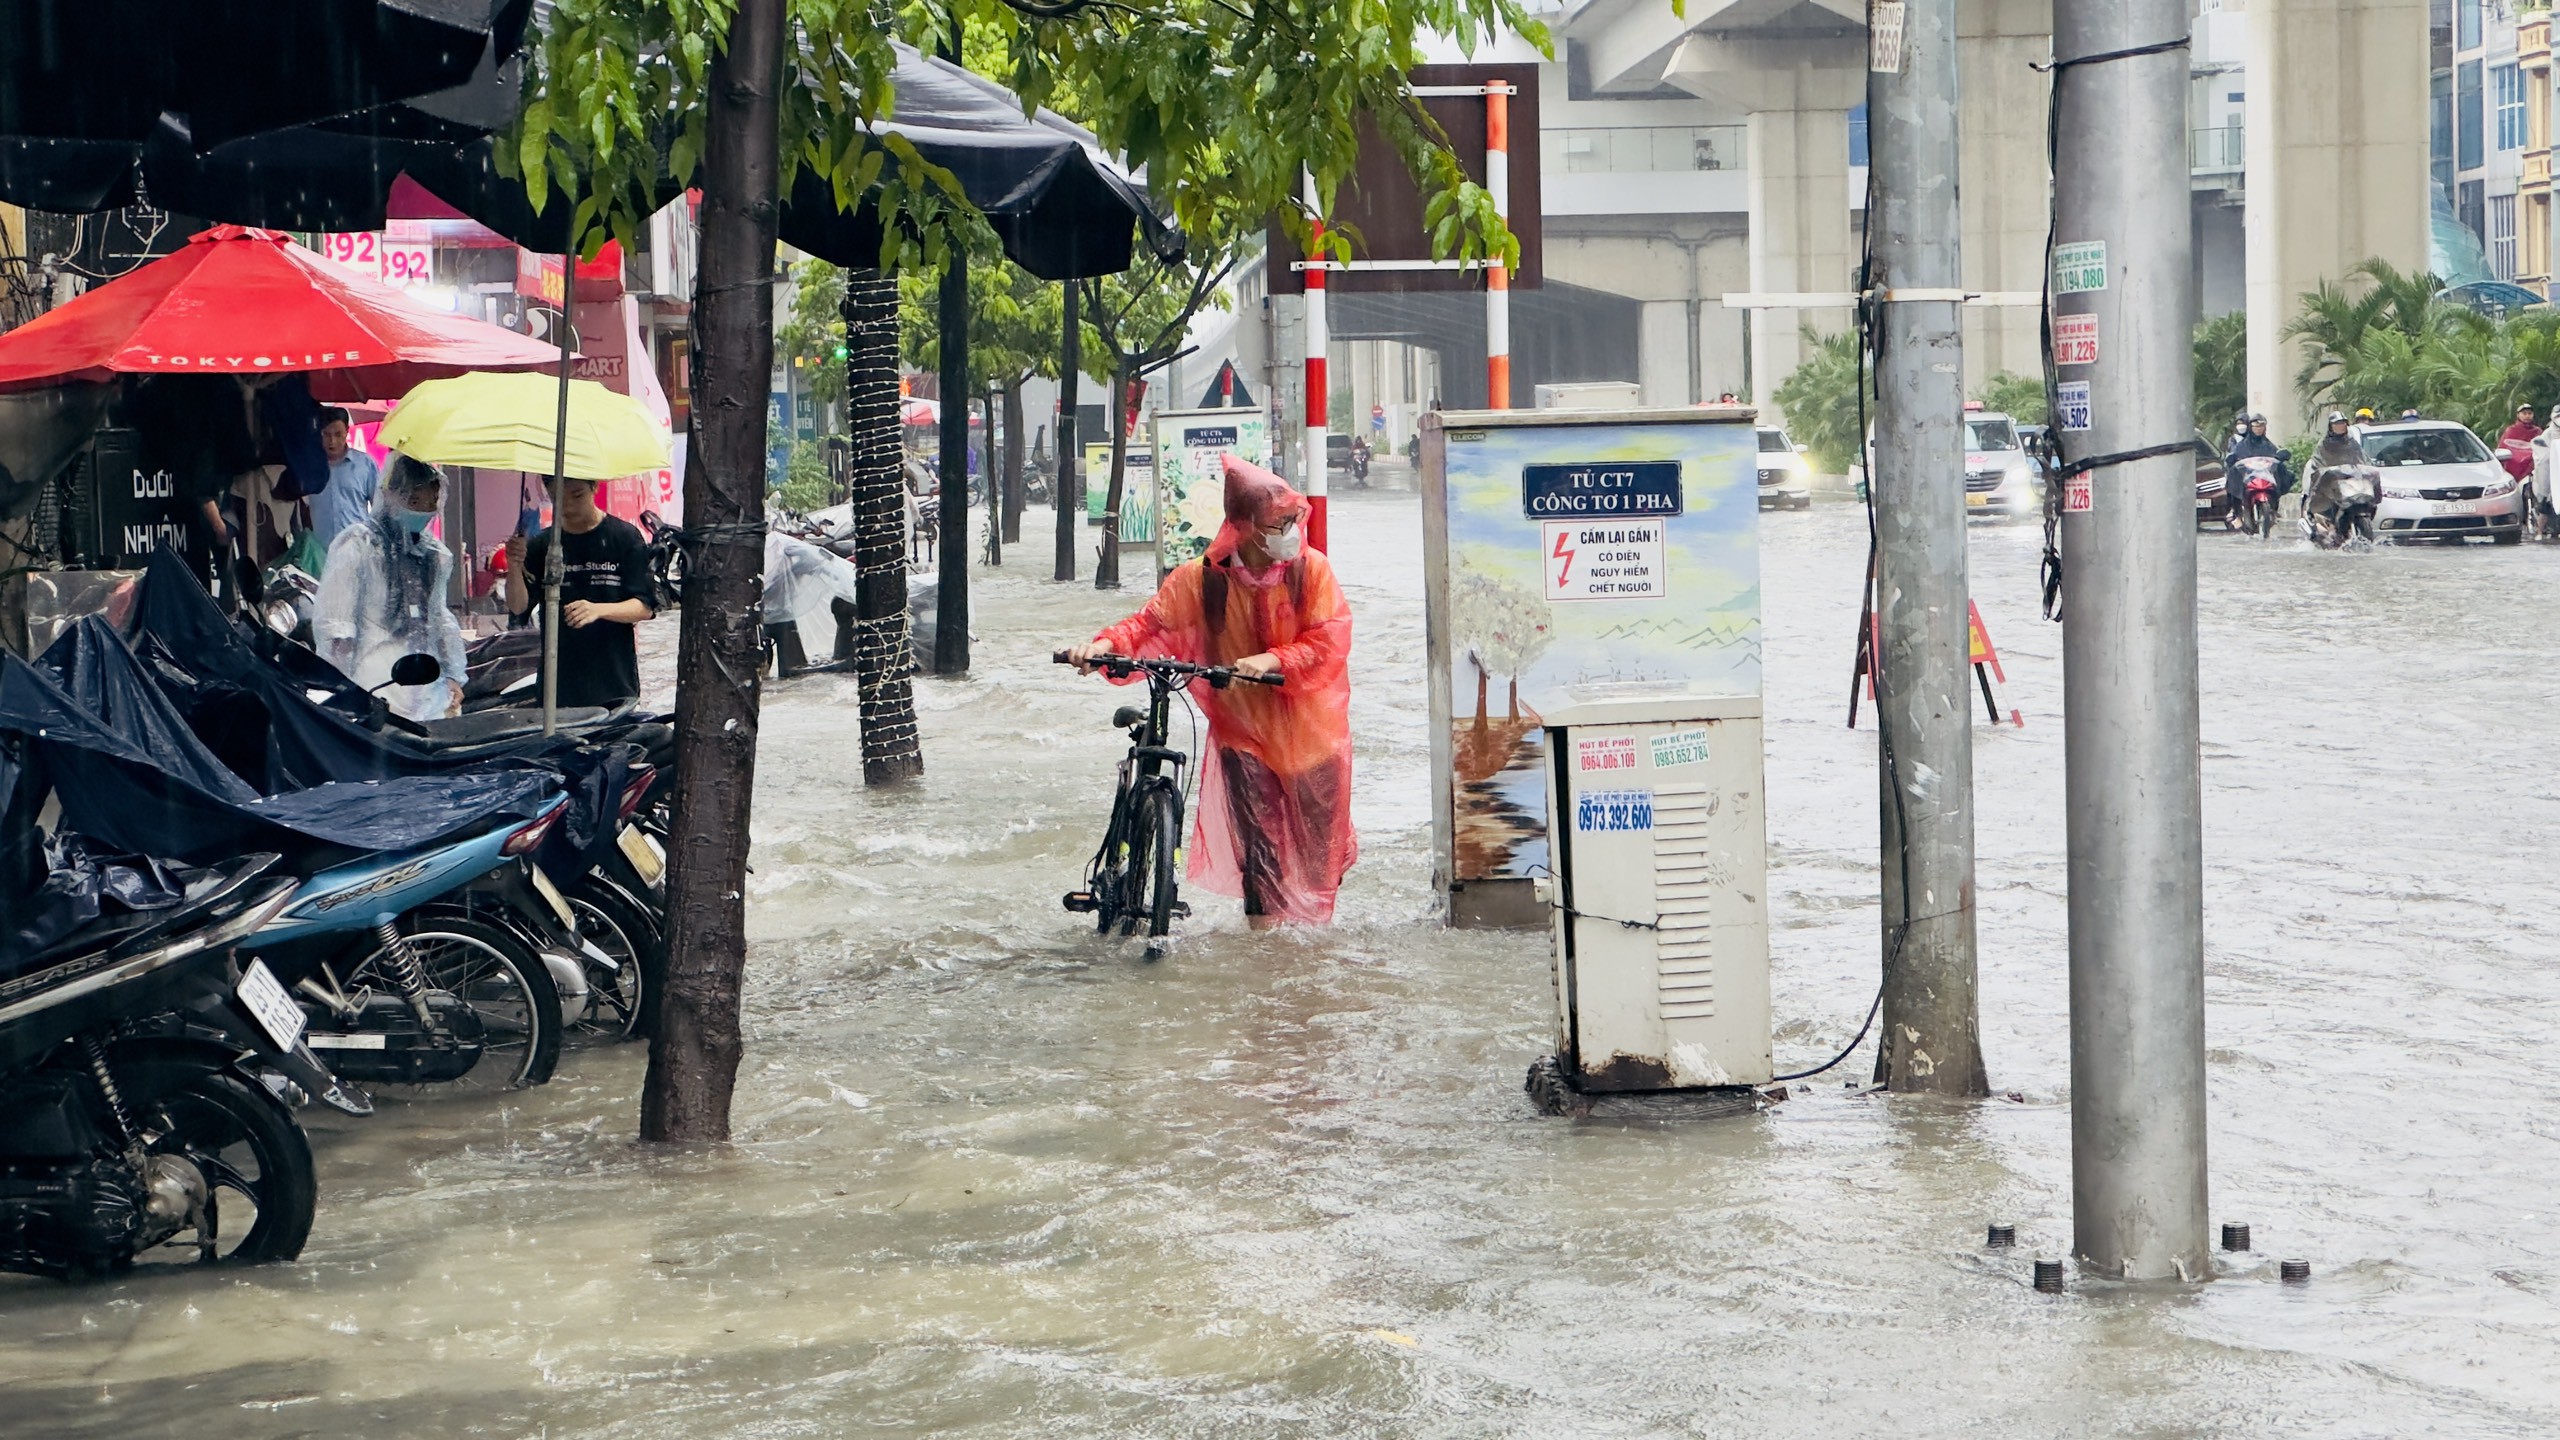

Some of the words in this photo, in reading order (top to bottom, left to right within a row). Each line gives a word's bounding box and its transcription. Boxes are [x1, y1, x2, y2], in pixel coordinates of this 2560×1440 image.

[1570, 469, 1594, 488] TỦ
[1600, 472, 1634, 488] CT7
[1533, 492, 1587, 511] CÔNG
[1591, 494, 1619, 510] TƠ
[1623, 495, 1630, 509] 1
[1636, 494, 1674, 509] PHA
[1580, 527, 1605, 544] CẤM
[1609, 531, 1624, 546] LẠI
[1591, 568, 1620, 577] NGUY
[1579, 804, 1652, 831] 0973.392.600
